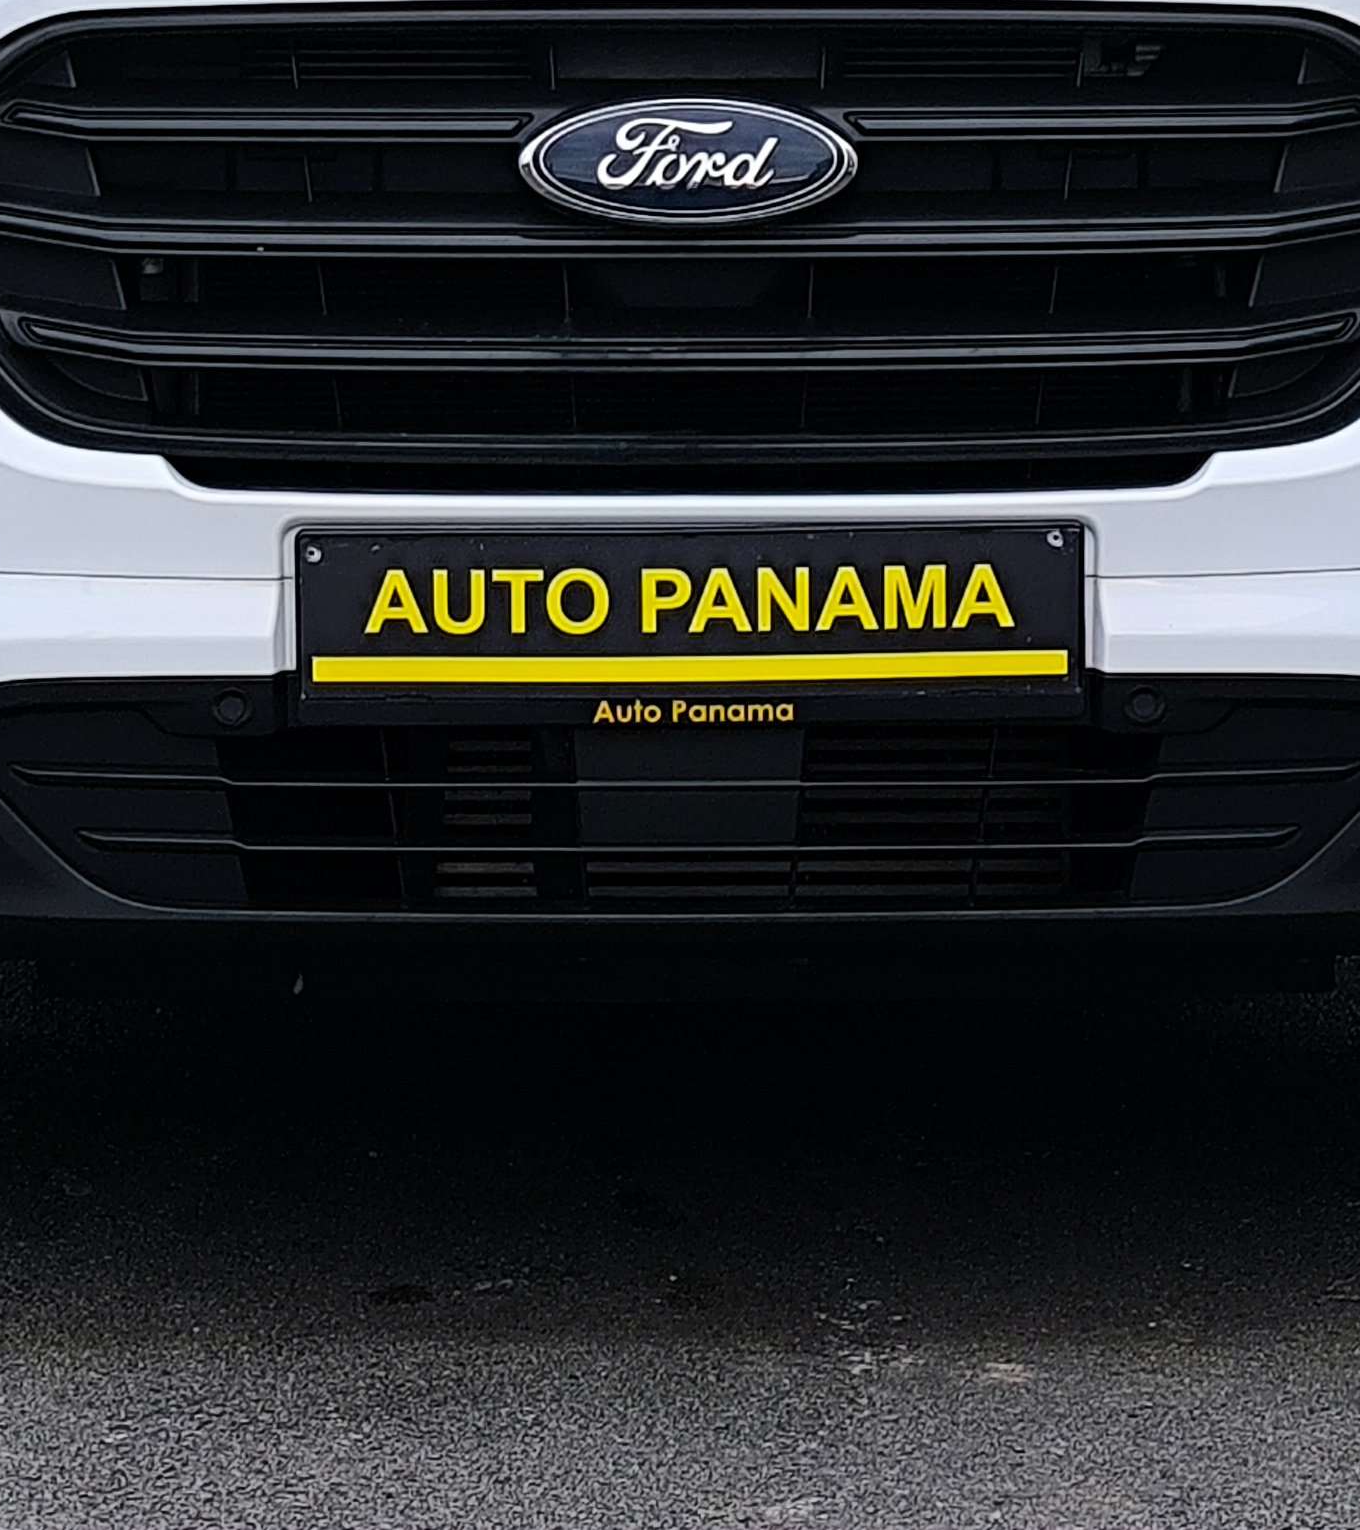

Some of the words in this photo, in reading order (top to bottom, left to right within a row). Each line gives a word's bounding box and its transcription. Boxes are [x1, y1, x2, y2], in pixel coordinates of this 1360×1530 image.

[597, 118, 779, 189] Ford
[365, 568, 610, 635] AUTO
[641, 564, 1016, 634] PANAMA
[593, 701, 645, 724] Auto
[671, 700, 796, 724] Panama
